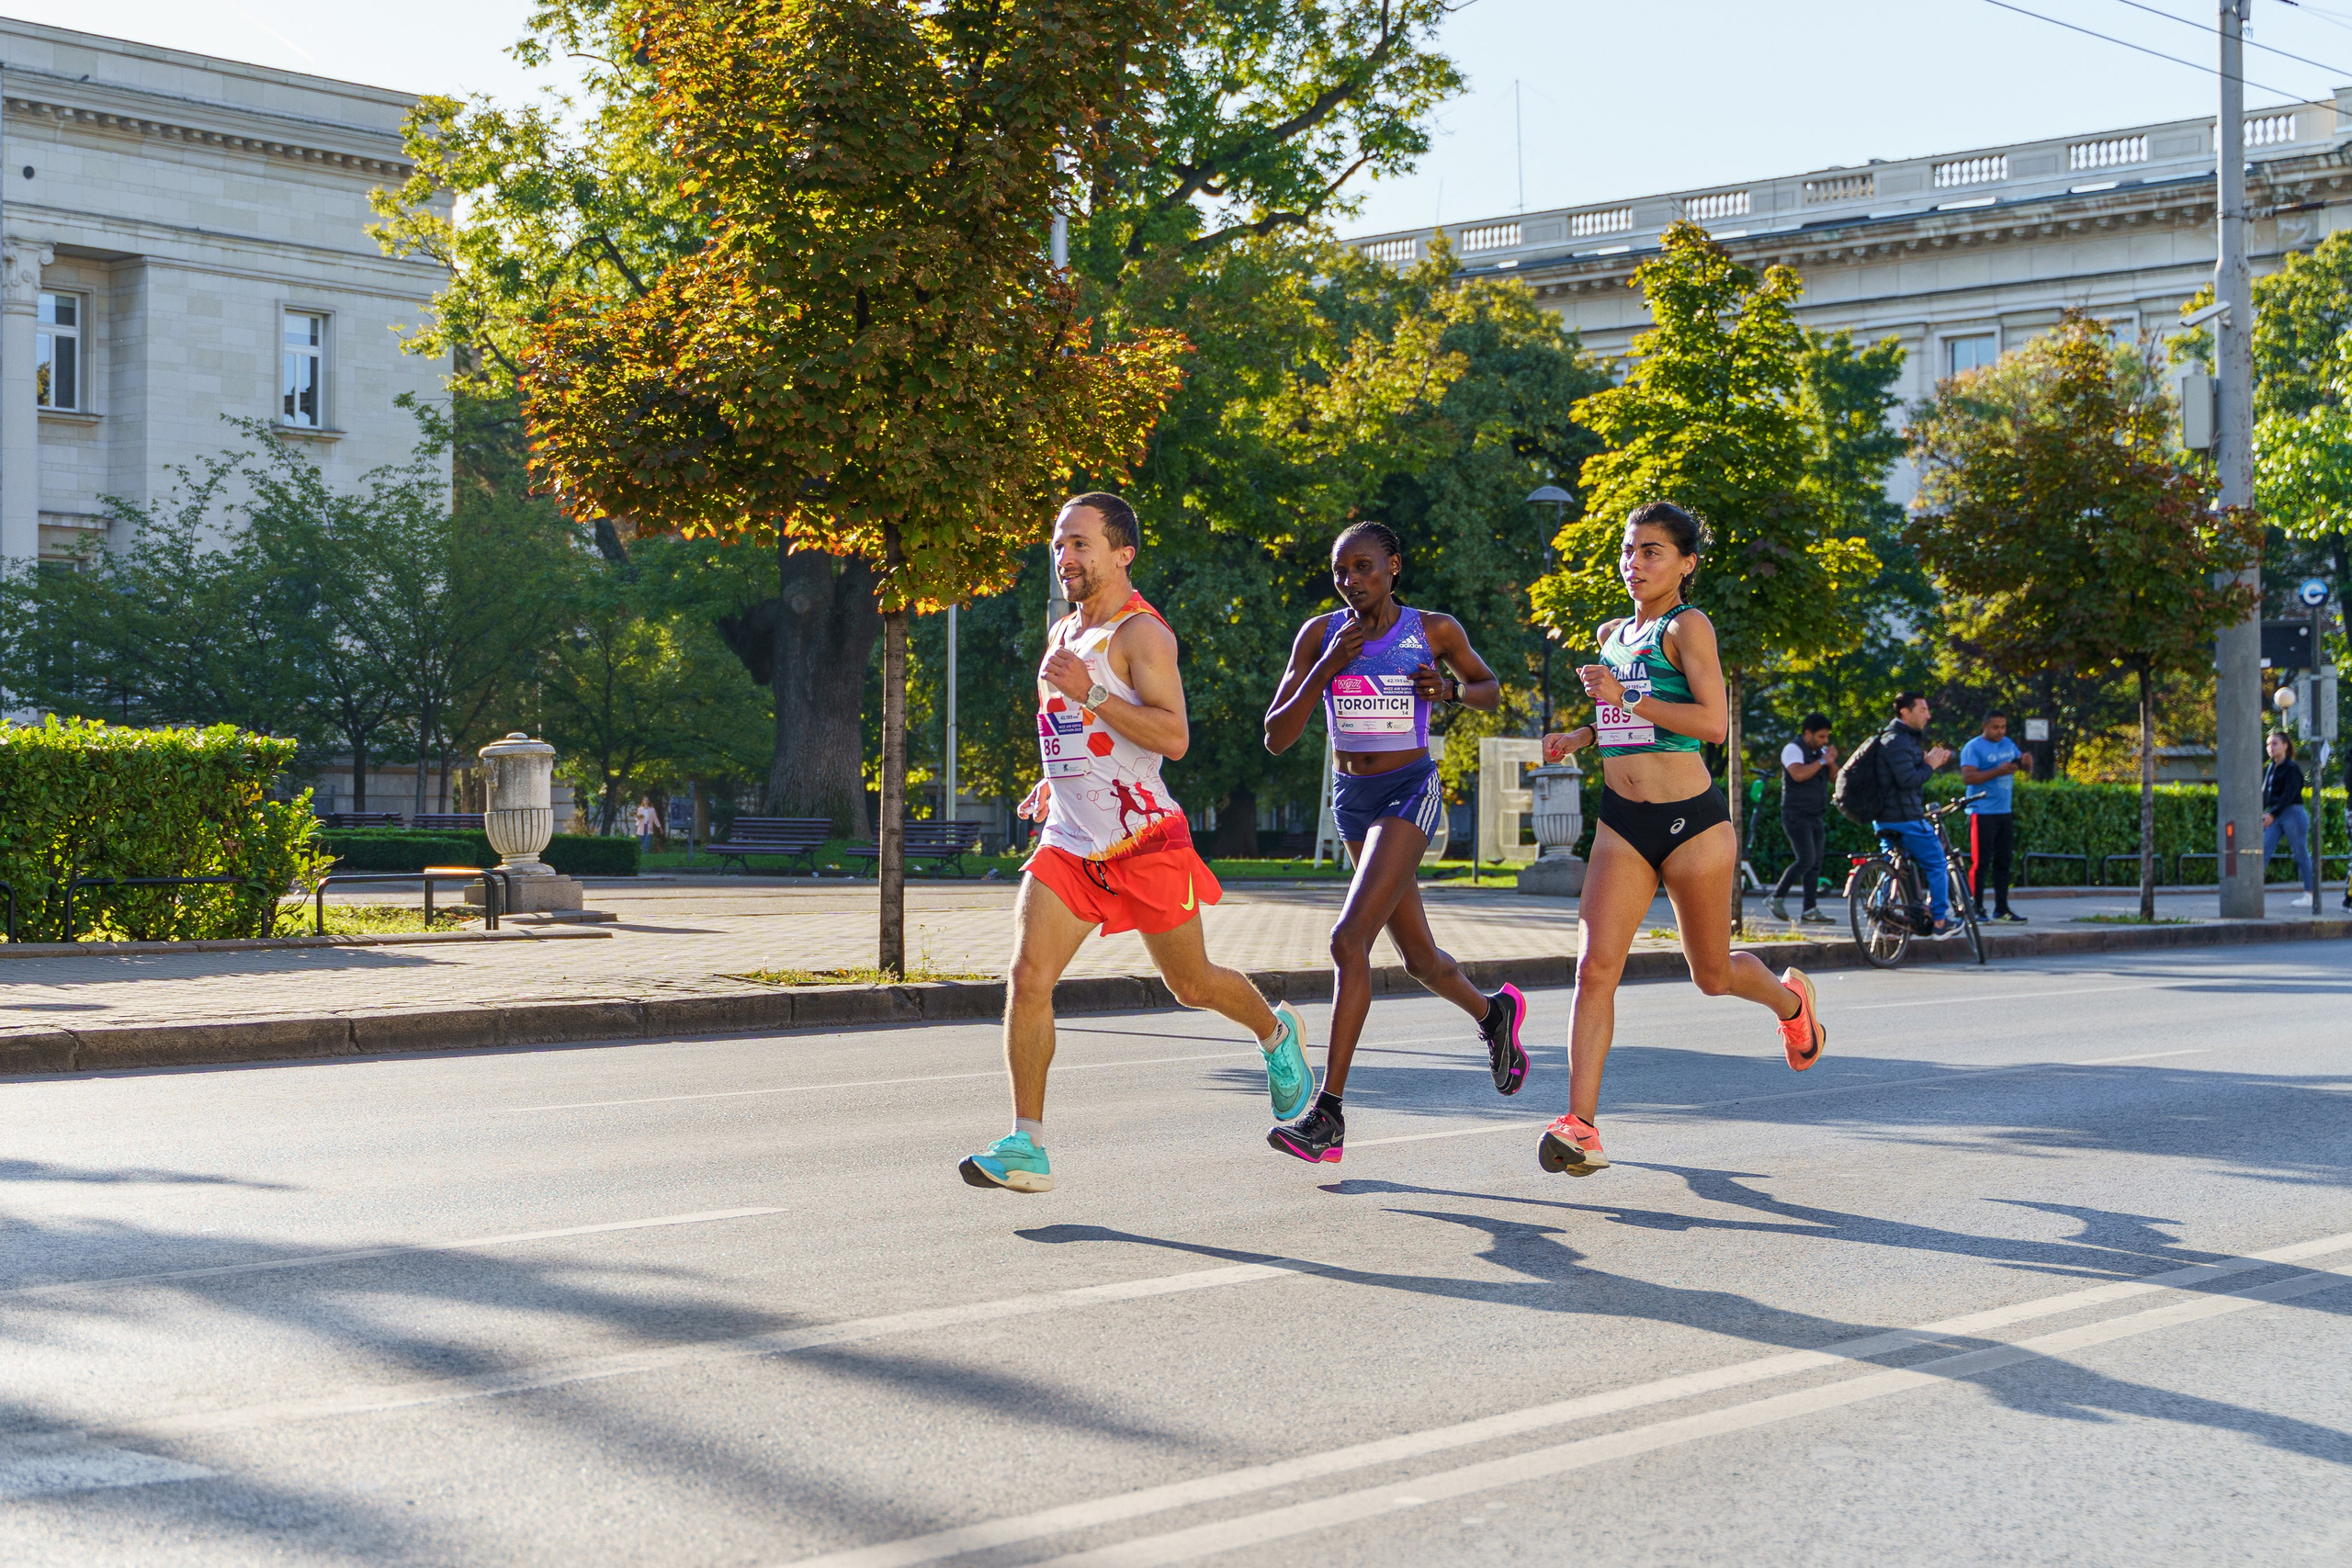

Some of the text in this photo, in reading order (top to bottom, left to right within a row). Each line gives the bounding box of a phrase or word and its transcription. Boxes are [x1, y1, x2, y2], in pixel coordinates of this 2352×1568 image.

[1610, 662, 1647, 680] GARIA
[1337, 699, 1408, 710] TOROITICH
[1044, 738, 1060, 756] 86
